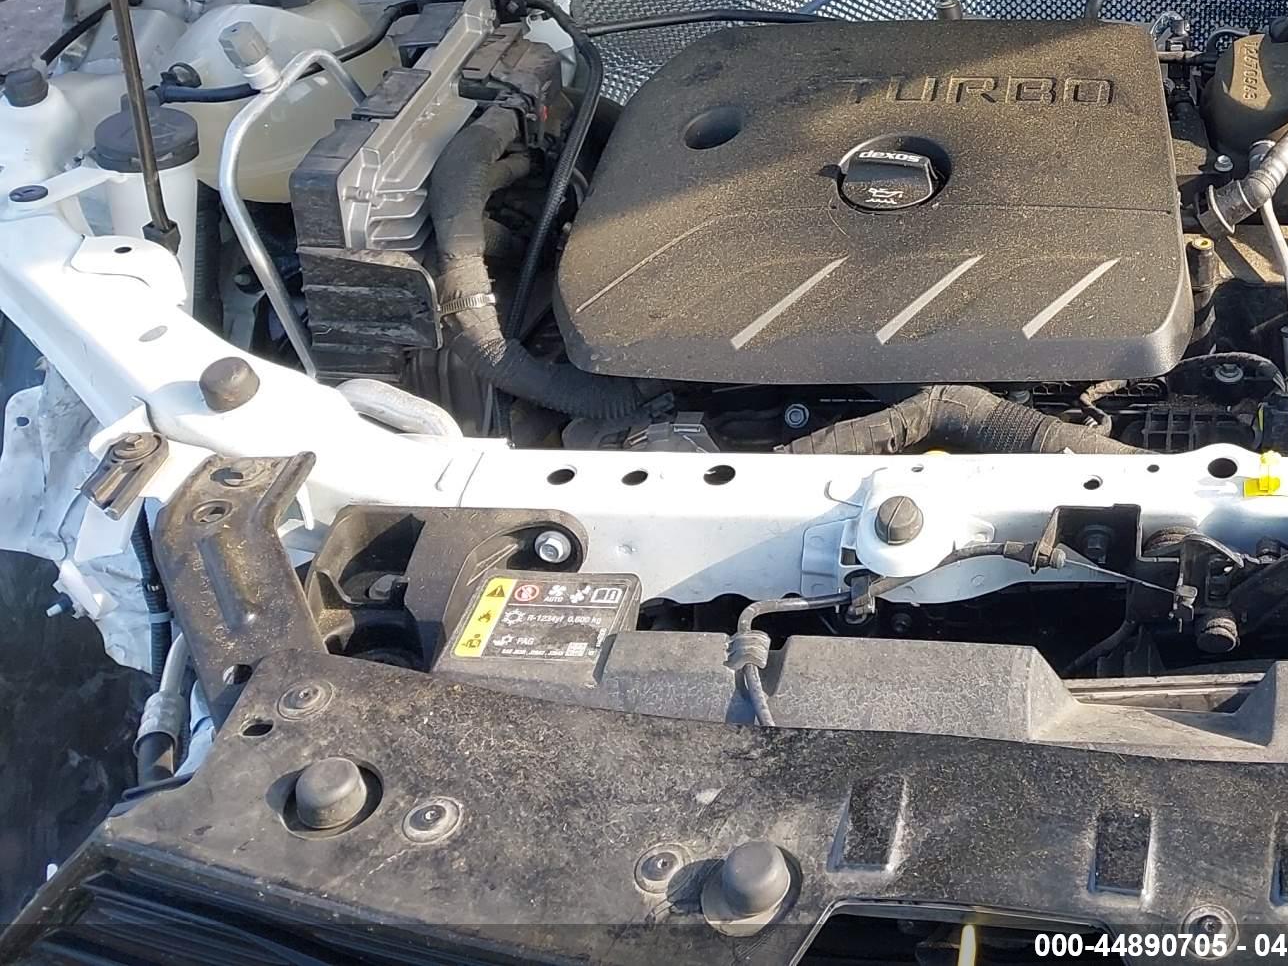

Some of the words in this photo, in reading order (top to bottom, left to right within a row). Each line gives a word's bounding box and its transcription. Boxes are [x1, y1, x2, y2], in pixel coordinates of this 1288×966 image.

[832, 75, 1115, 105] TURBO
[858, 149, 921, 163] dexos
[516, 637, 535, 645] PAG
